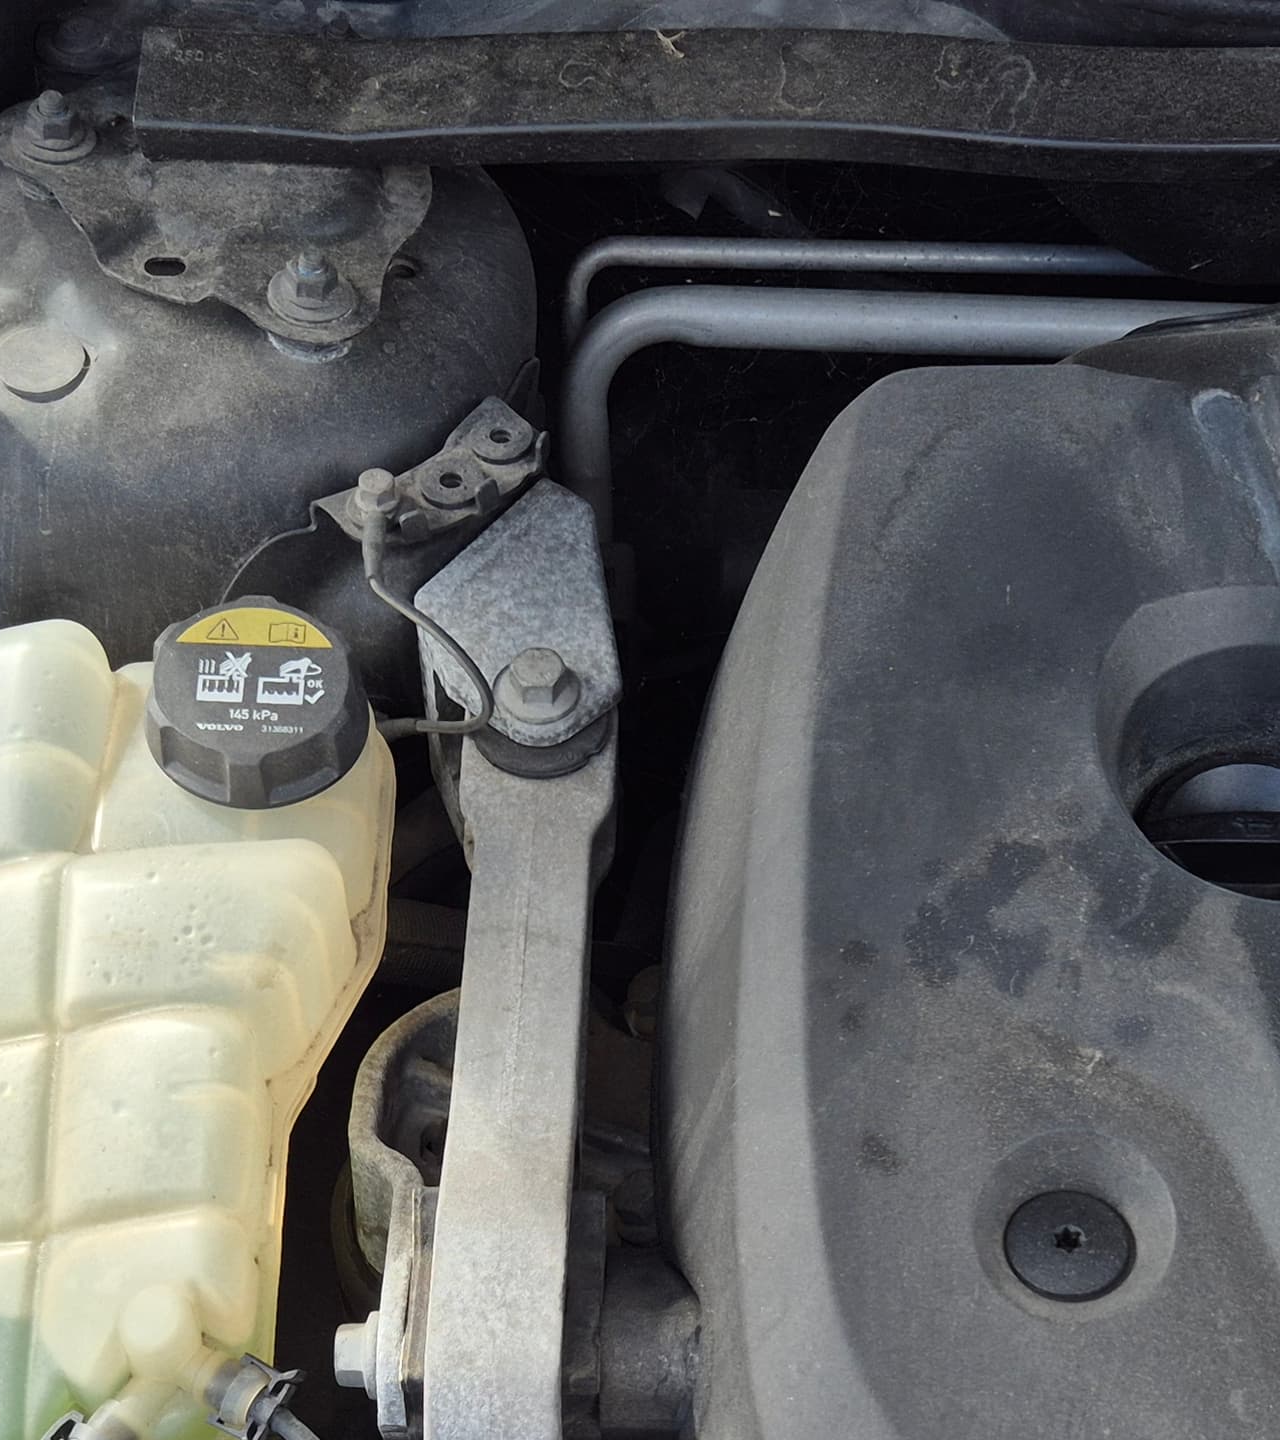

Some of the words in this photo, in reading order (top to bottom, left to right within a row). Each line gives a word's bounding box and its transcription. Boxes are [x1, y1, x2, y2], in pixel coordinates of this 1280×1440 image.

[307, 679, 324, 689] OK
[229, 708, 249, 720] 145
[253, 708, 278, 721] kPa
[196, 722, 244, 732] VOLVO
